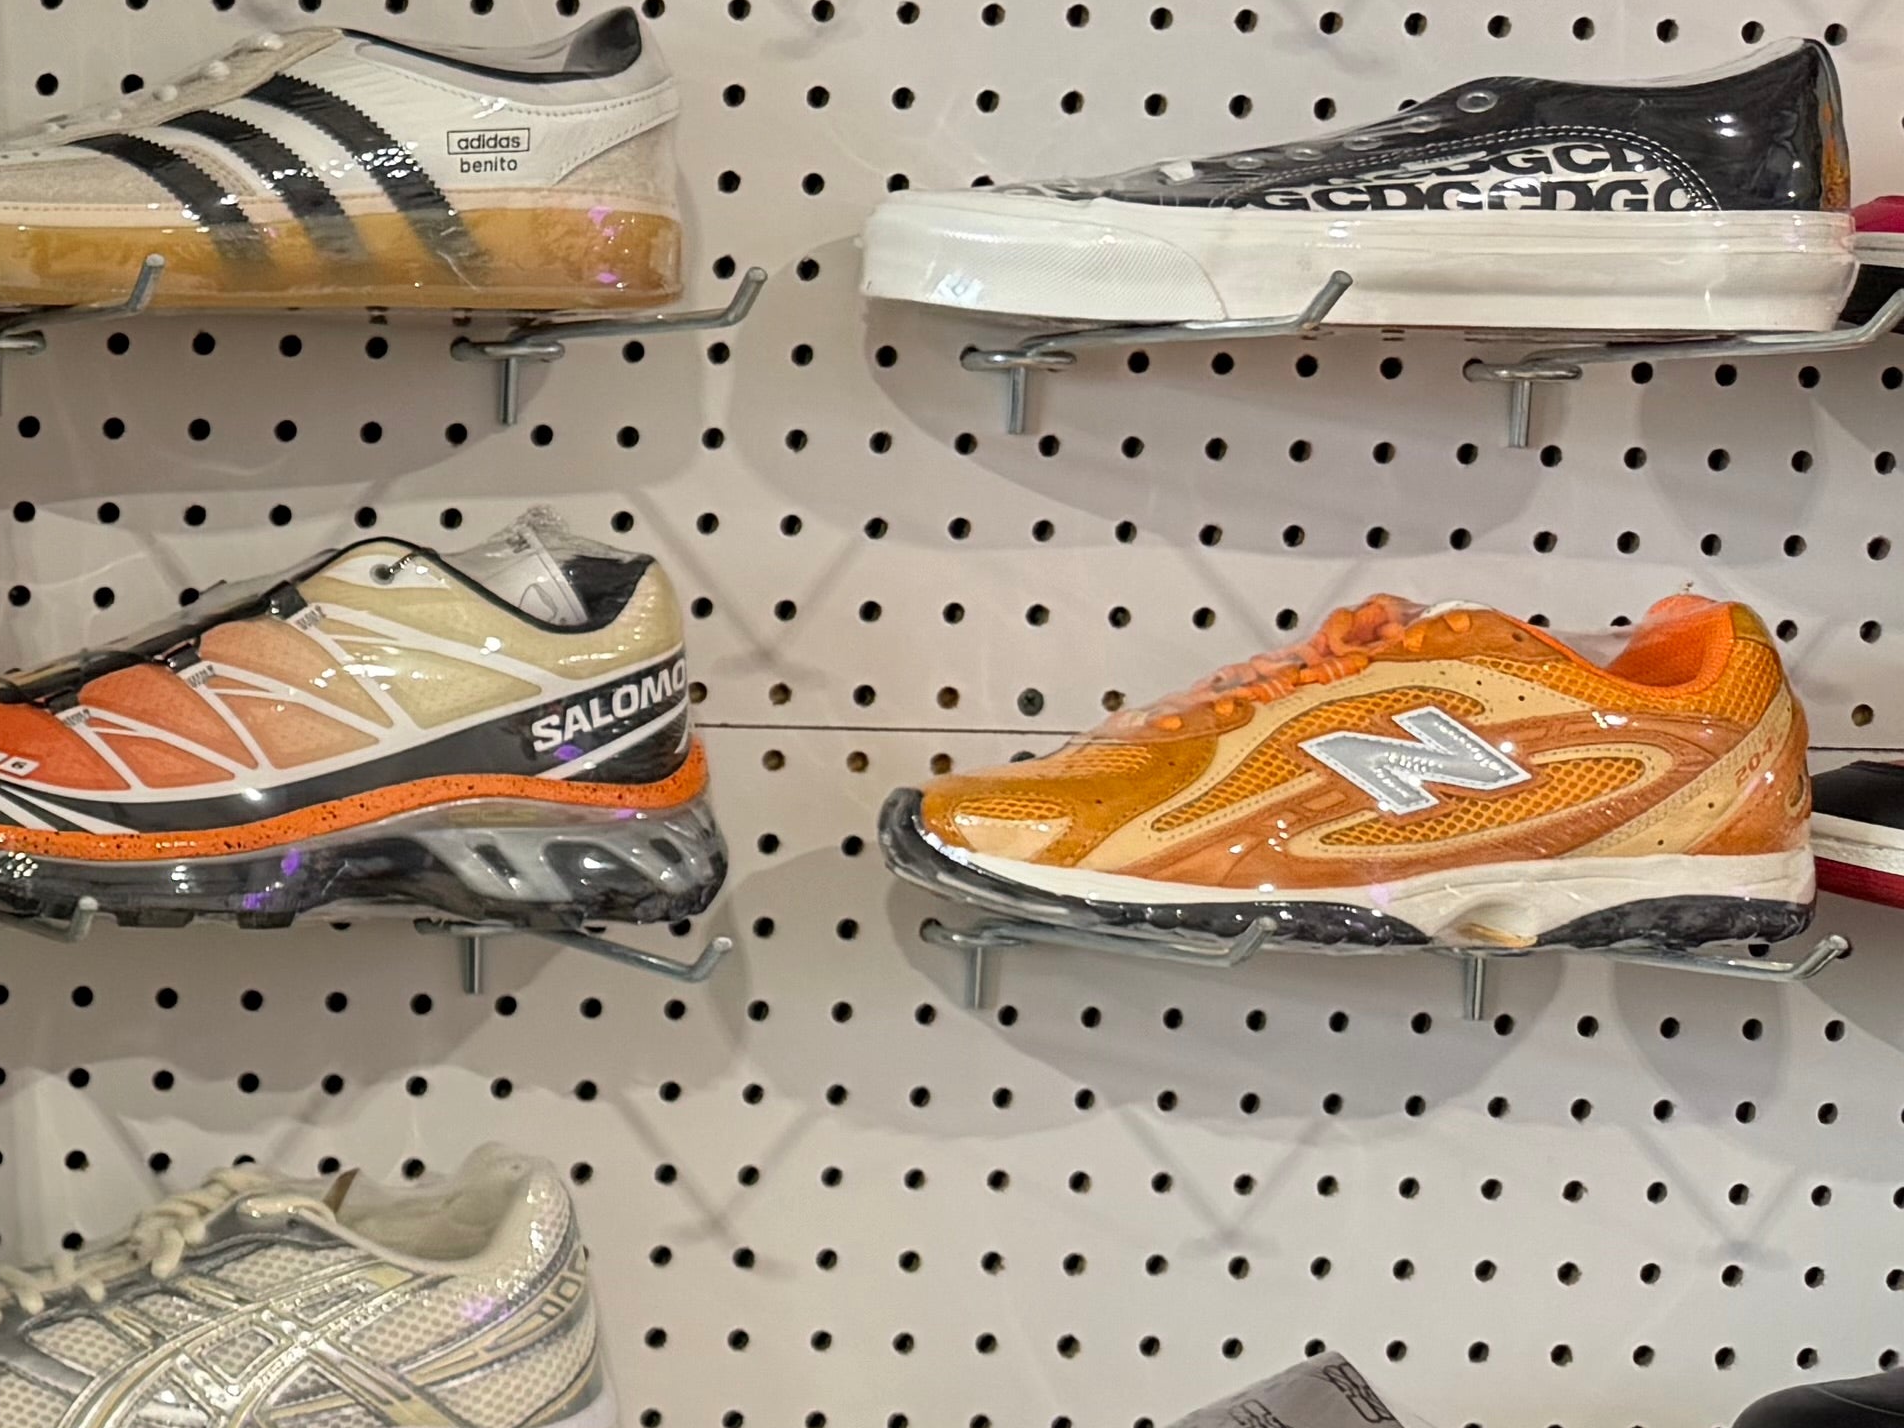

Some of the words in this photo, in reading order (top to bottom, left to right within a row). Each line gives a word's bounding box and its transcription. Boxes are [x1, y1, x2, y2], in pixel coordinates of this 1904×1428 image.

[457, 133, 521, 150] adidas
[460, 156, 518, 173] benito
[532, 658, 686, 752] SALOMO
